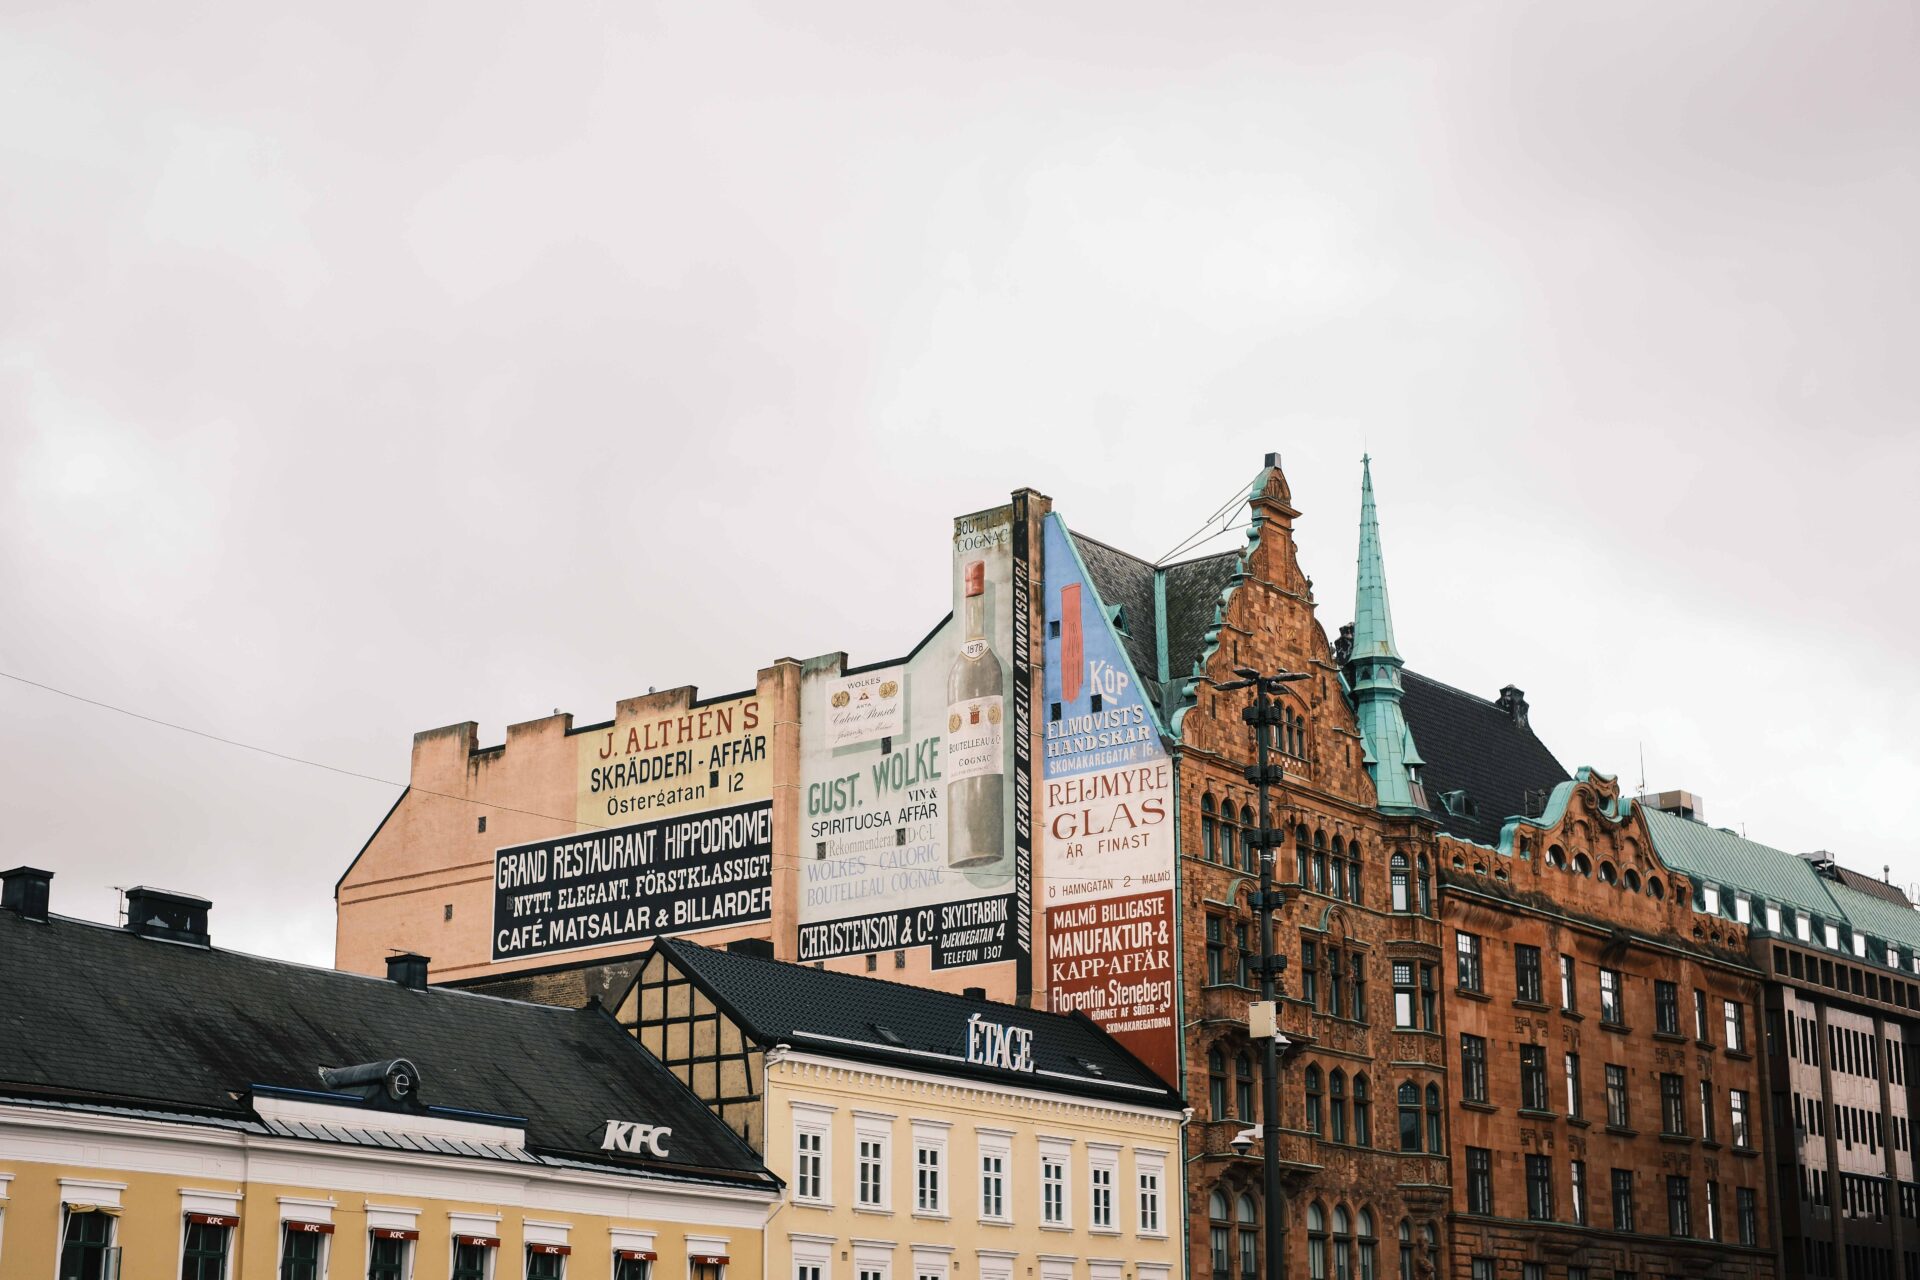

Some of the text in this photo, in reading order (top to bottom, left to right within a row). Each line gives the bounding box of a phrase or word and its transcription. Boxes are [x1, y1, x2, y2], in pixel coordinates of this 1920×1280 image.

[957, 528, 1009, 553] COGNAC
[967, 642, 984, 654] 1878
[847, 676, 881, 689] WOLKES
[600, 701, 759, 759] J. ALTHÉN'S
[1046, 703, 1144, 741] ELMQVIST'S
[1046, 725, 1151, 759] HANDSKAR
[591, 749, 692, 793] SKRÄDDERI
[709, 734, 766, 769] AFFÄR
[808, 736, 942, 817] GUST. WOLKE
[958, 754, 992, 767] COGNAC
[1050, 746, 1138, 776] SKOMAKAREGATAN
[607, 772, 744, 816] Östergatan 12
[1016, 766, 1030, 840] GENOM
[1048, 765, 1168, 808] REIJMYRE
[811, 801, 938, 838] SPIRITUOSA AFFÄR
[1052, 798, 1166, 840] GLAS
[498, 849, 548, 890] GRAND
[553, 829, 658, 881] RESTAURANT
[828, 830, 895, 857] Rekommenderar
[1066, 833, 1151, 859] ÄR FINAST
[807, 842, 941, 883] WOLKES CALORIC
[513, 891, 553, 917] NYTT,
[557, 878, 631, 910] ELEGANT,
[807, 864, 945, 908] BOUTELLEAU COGNAC
[1062, 879, 1114, 896] HAMNGATAN
[1123, 875, 1132, 888] 2
[1142, 870, 1172, 885] MALMÖ
[941, 898, 1009, 930] SKYLTFABRIK
[1017, 845, 1031, 955] ANNONSERA
[1053, 897, 1165, 930] MALMÖ BILLIGASTE
[497, 886, 772, 953] CAFÉ, MATSALAR & BILLARDER
[996, 922, 1006, 941] 4
[800, 915, 898, 959] CHRISTENSON
[900, 916, 913, 946] &
[943, 945, 1003, 965] TELEFON 1307
[1052, 949, 1171, 982] KAPP-AFFÄR
[1053, 976, 1172, 1013] Florentin Steneberg
[1091, 1008, 1118, 1021] HÖRNET
[1121, 1006, 1129, 1018] AF
[1106, 1016, 1172, 1034] SKOMAKAREGATORNA
[966, 1012, 1034, 1073] ÉTAGE
[600, 1119, 673, 1157] KFC
[206, 1216, 224, 1226] KFC
[304, 1224, 320, 1233] KFC
[390, 1231, 405, 1240] KFC
[472, 1237, 488, 1246] KFC
[545, 1245, 560, 1254] KFC
[634, 1252, 647, 1260] KFC
[707, 1257, 720, 1265] KFC
